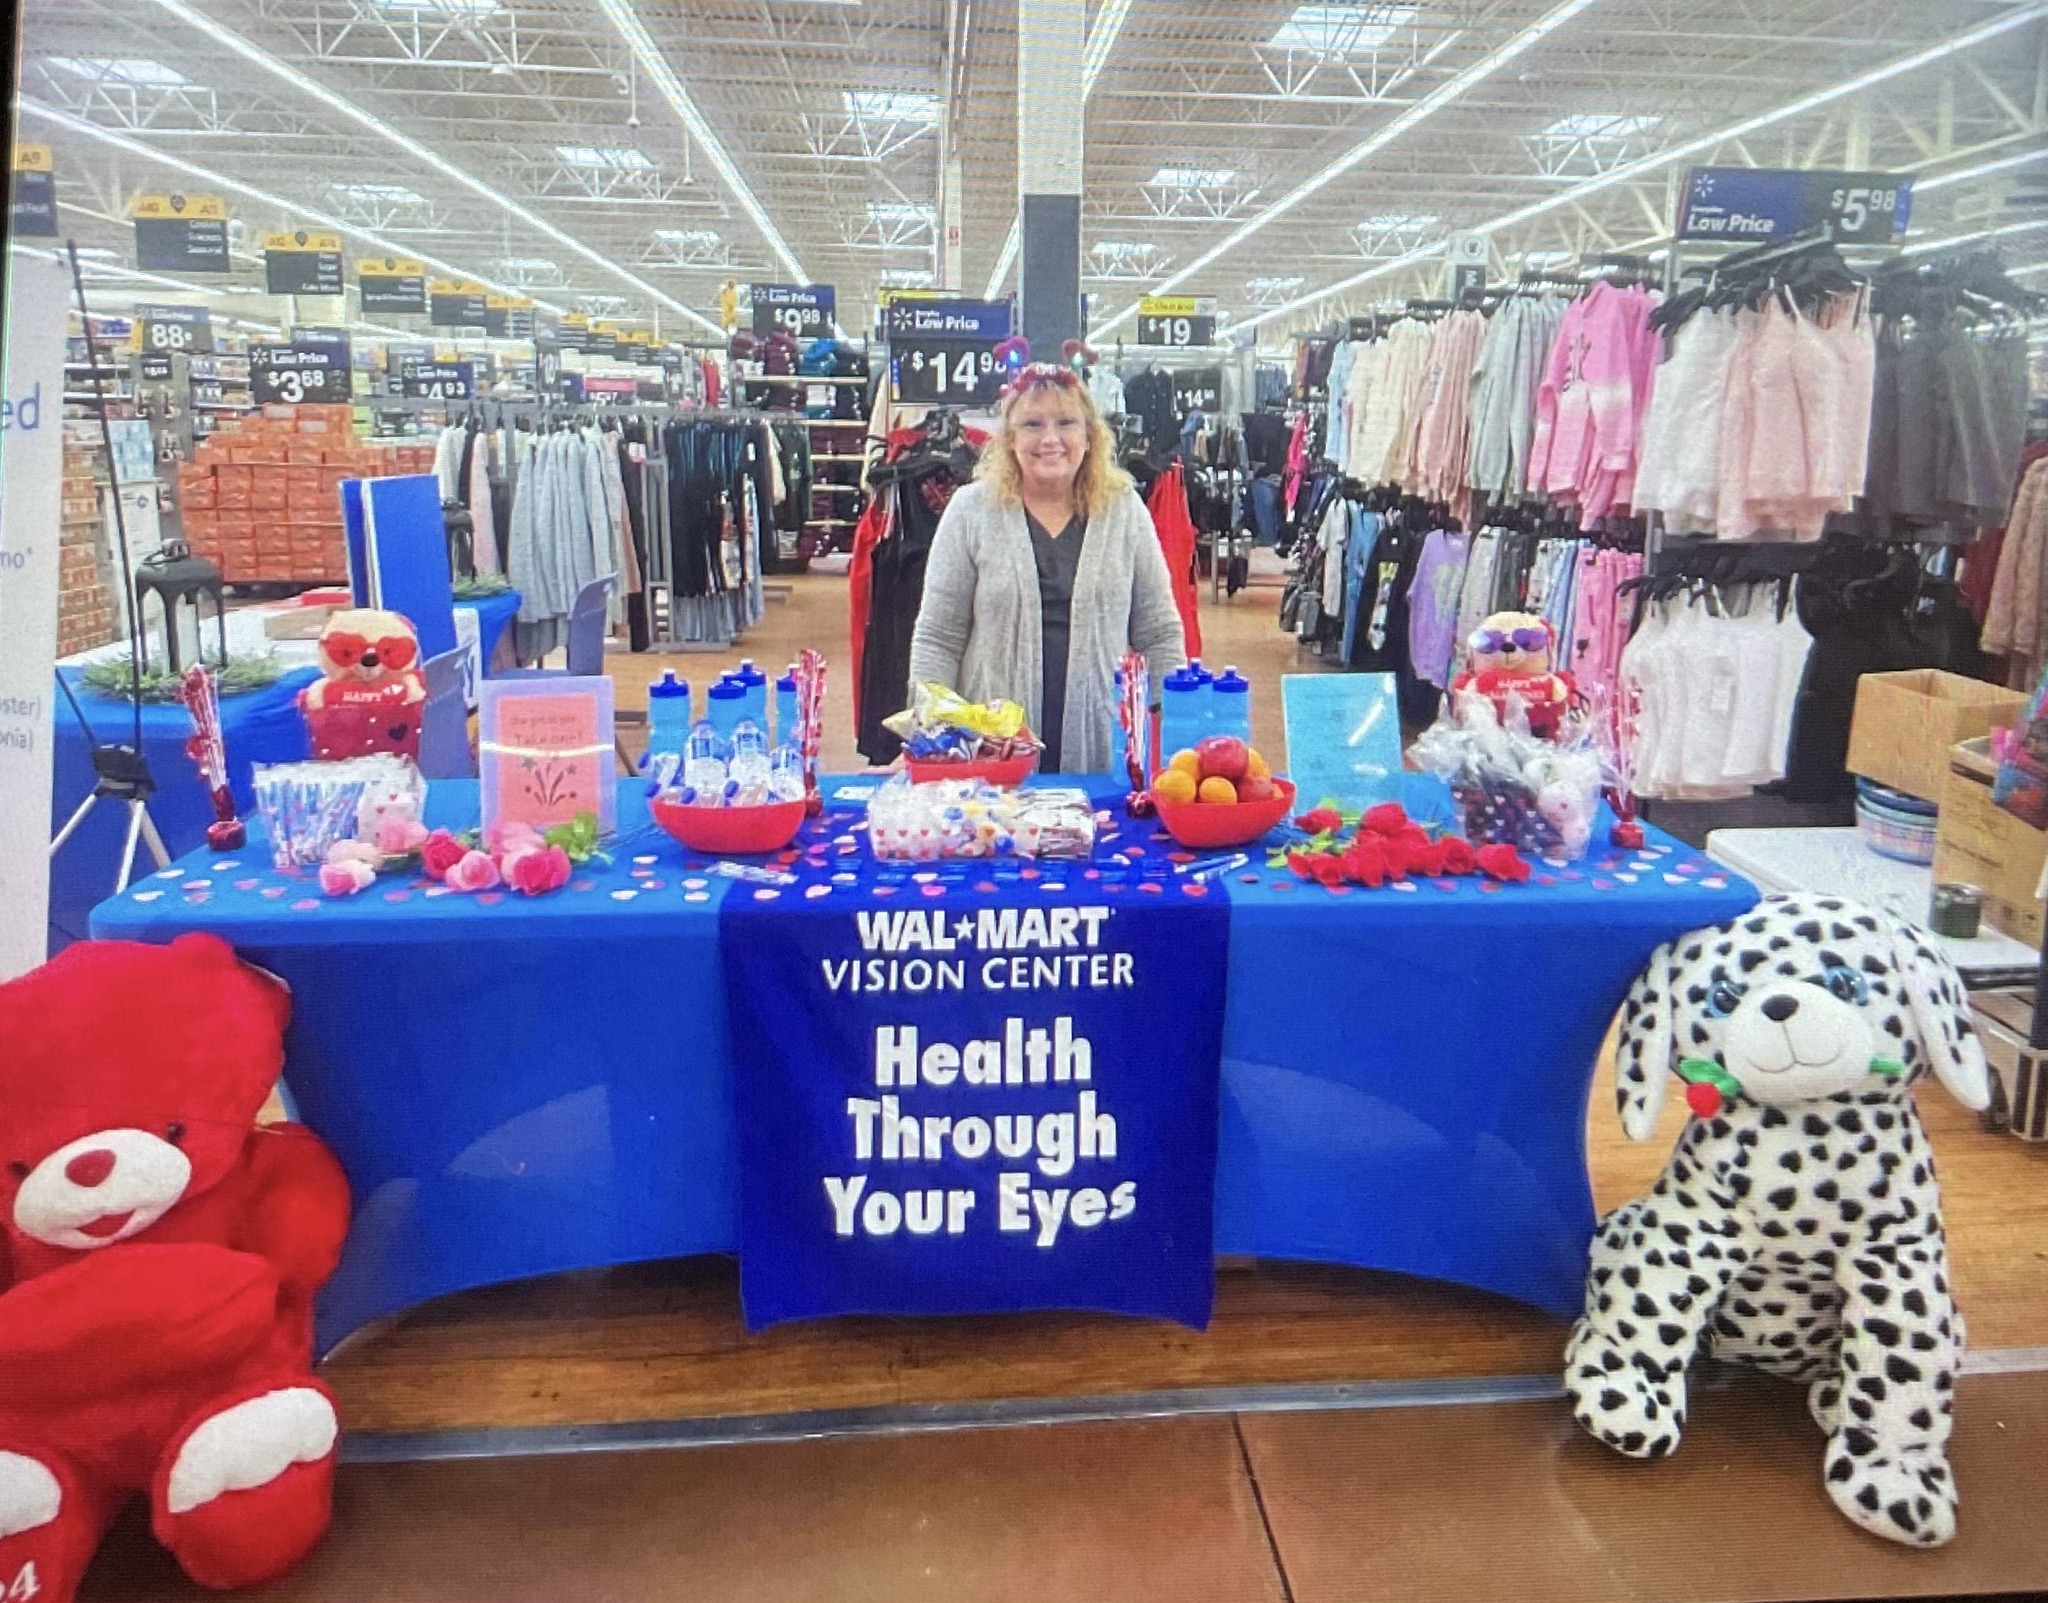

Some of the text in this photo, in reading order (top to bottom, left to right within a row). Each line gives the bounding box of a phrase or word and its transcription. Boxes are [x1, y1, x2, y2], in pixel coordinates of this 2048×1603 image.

[1686, 214, 1775, 233] Low Price
[915, 316, 980, 331] Low Price
[298, 352, 329, 364] Price
[822, 952, 1135, 991] VISION CENTER
[876, 1016, 1092, 1086] Health
[847, 1090, 1117, 1176] Through
[823, 1172, 1137, 1247] Your Eyes
